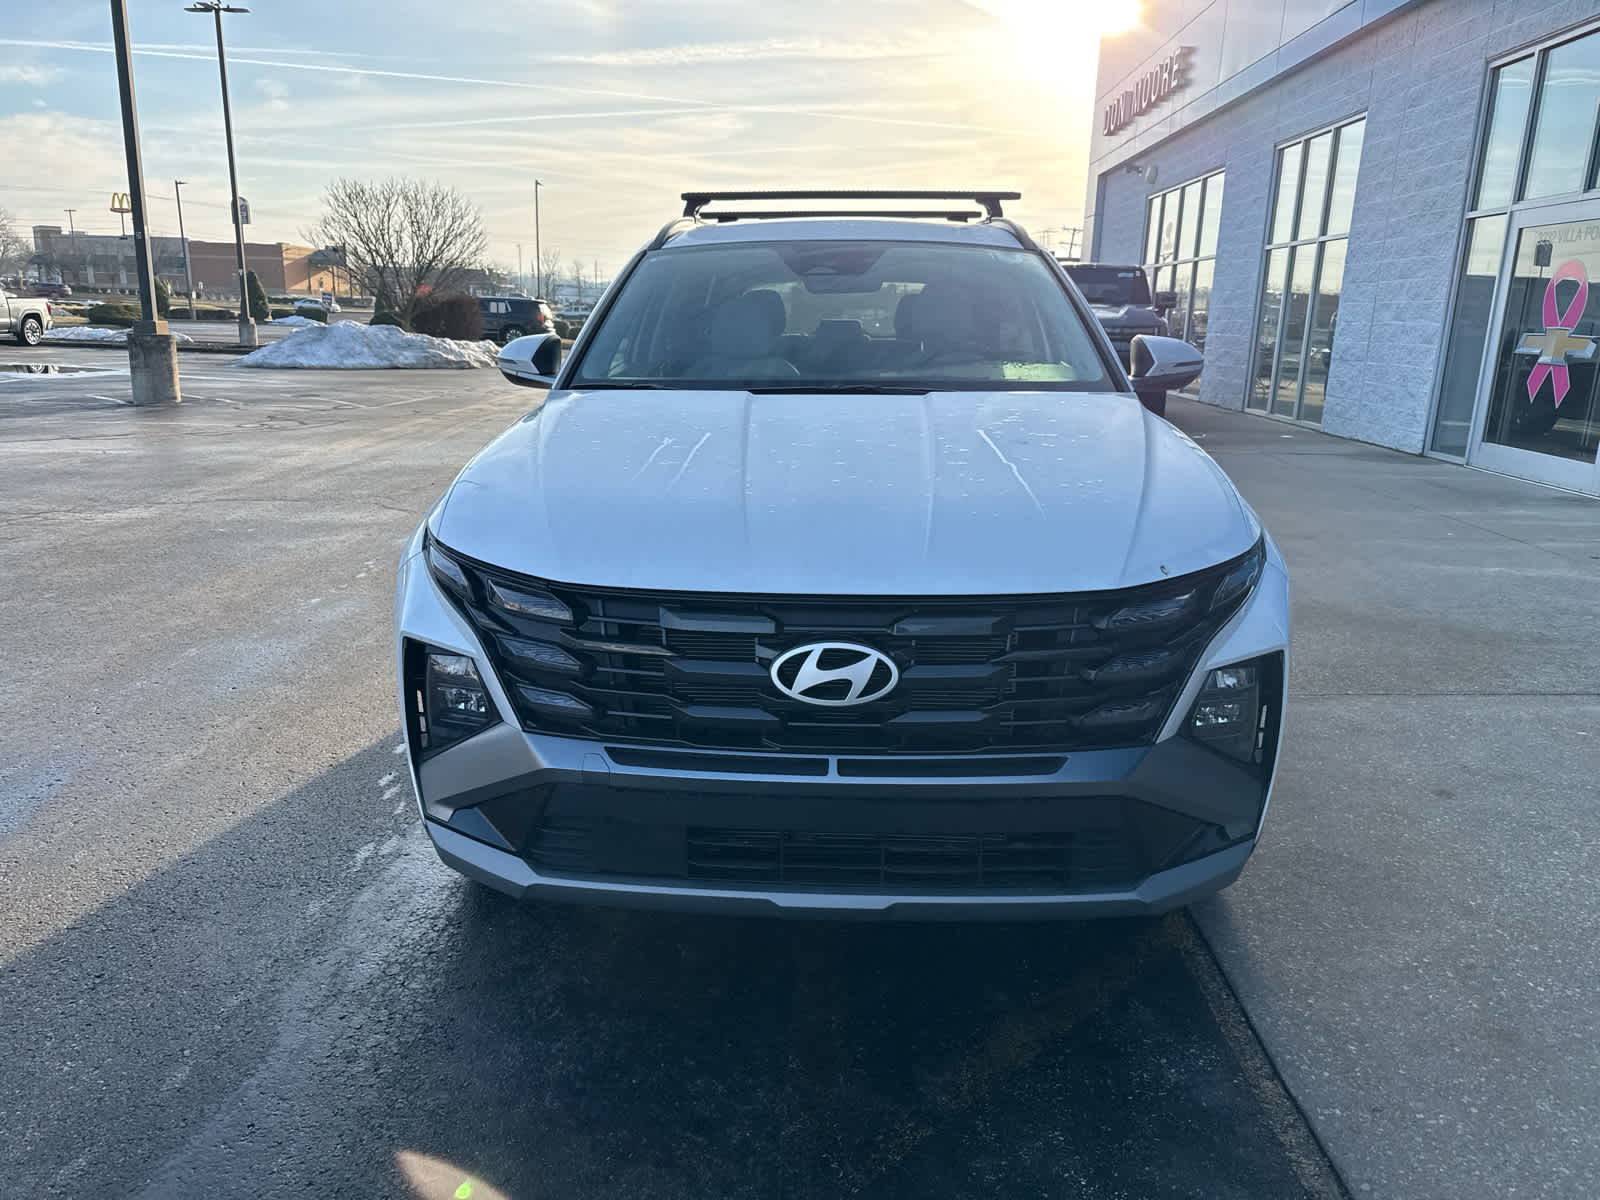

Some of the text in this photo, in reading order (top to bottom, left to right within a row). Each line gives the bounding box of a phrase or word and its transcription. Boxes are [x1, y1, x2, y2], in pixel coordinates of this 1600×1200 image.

[1103, 46, 1186, 136] DON MOORE
[1558, 226, 1582, 242] VILLA
